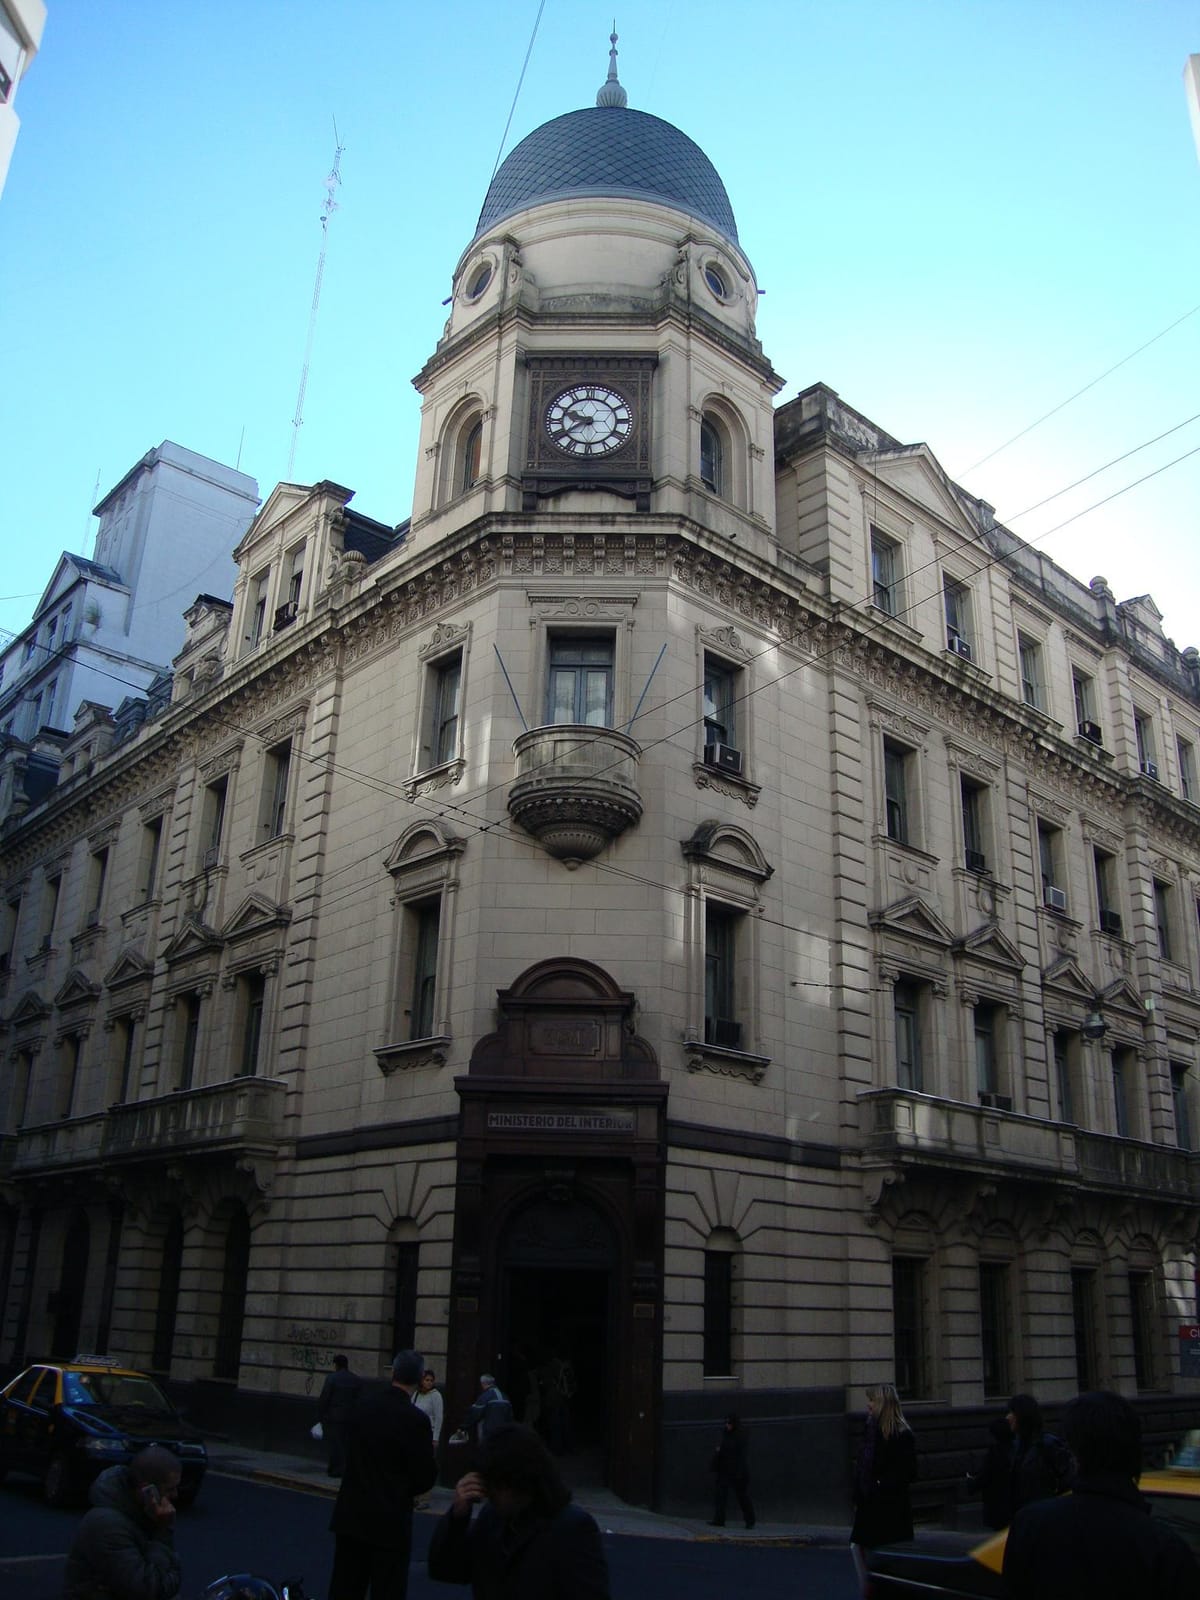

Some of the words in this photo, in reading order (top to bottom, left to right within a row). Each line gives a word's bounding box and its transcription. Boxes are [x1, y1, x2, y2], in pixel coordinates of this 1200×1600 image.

[489, 1115, 554, 1129] MINISTERIO
[557, 1116, 577, 1128] DEL
[579, 1116, 633, 1130] INTERIOR
